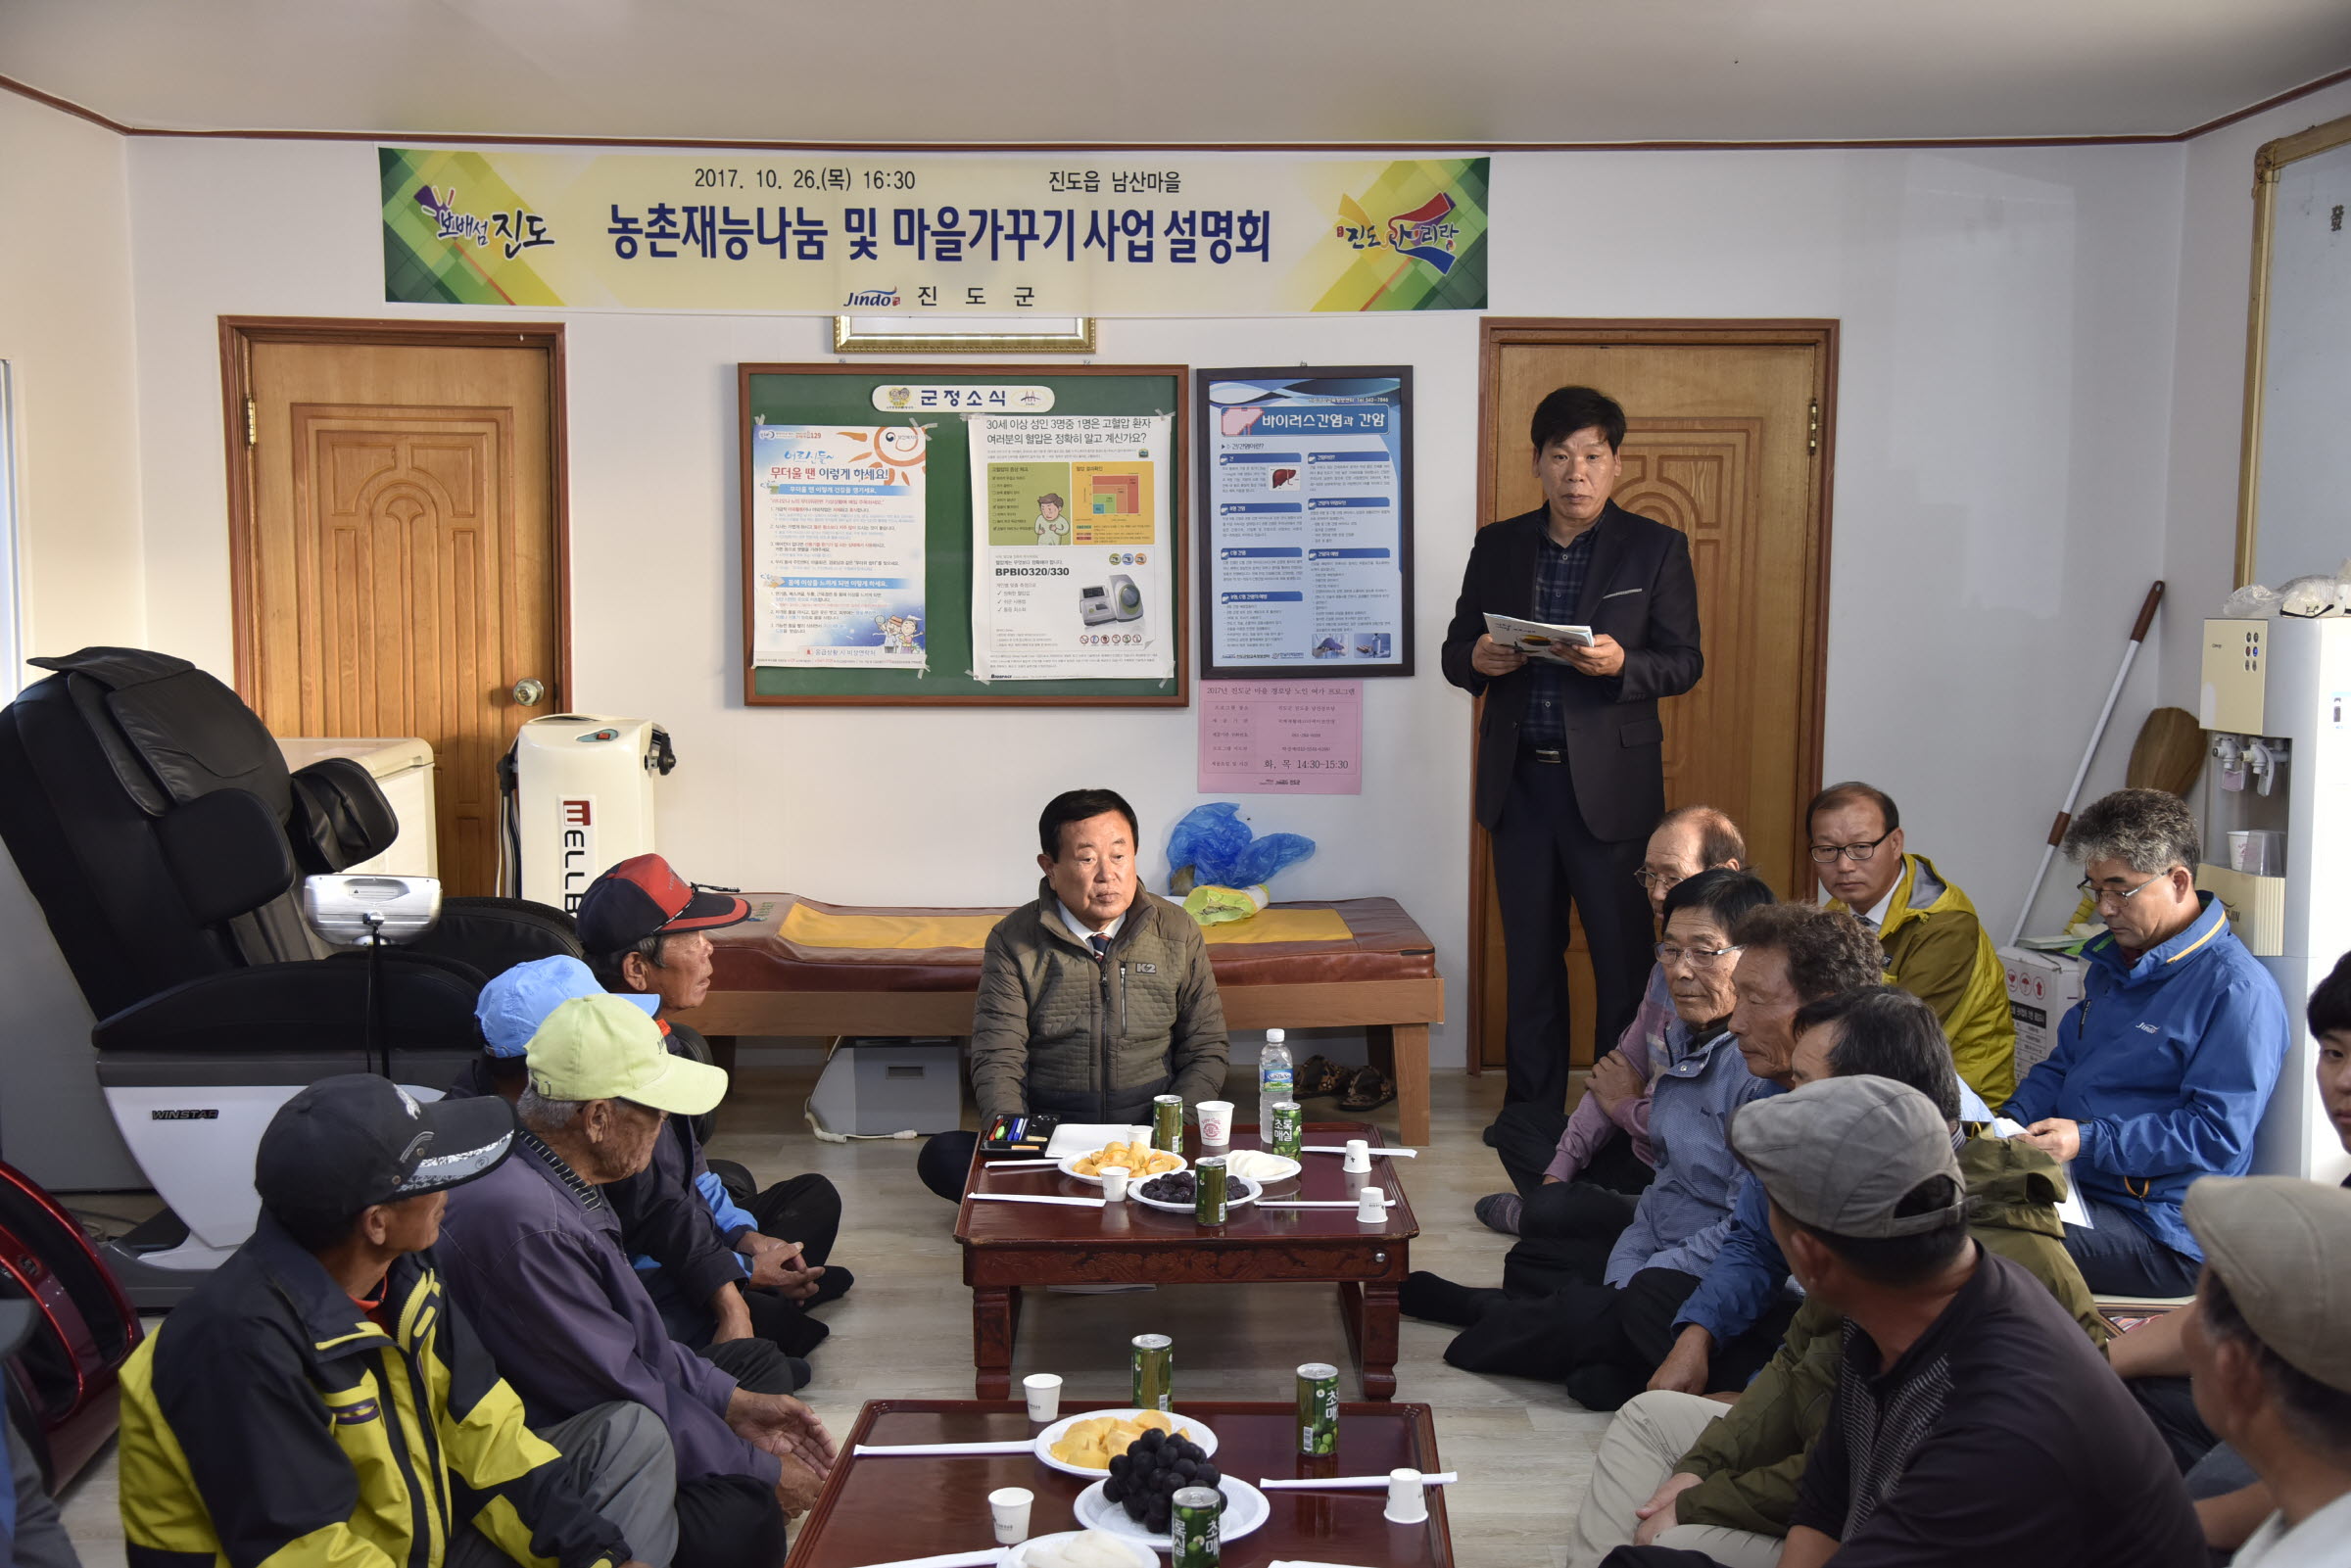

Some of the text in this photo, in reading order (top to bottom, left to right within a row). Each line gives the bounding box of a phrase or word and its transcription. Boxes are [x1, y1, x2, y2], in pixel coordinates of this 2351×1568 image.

[695, 167, 916, 192] 2017. 10. 26.(목) 16:30
[1048, 169, 1182, 194] 진도읍 남산마을
[438, 209, 556, 260] 보배섬 진도
[606, 202, 829, 261] 농촌재능나눔
[843, 206, 880, 261] 및
[1082, 208, 1155, 263] 사업
[1162, 209, 1271, 264] 설명회
[1345, 225, 1381, 250] 진도
[843, 290, 893, 308] Jindo
[985, 418, 1152, 430] 30세 이상 성인 3명중 1명은 고혈압 환자
[1358, 412, 1385, 428] 간암
[987, 433, 1147, 445] 여러분의 혈압은 정확히 알고 계신가요?
[770, 466, 889, 481] 무더울 땐 이렇게 하세요!
[995, 567, 1070, 577] BPBIO320/330
[1264, 759, 1277, 769] 화,
[1281, 759, 1292, 770] 목
[1136, 963, 1157, 974] K2
[152, 1110, 218, 1120] WINSTAR
[1273, 1118, 1293, 1130] 초록
[1273, 1130, 1293, 1142] 매실
